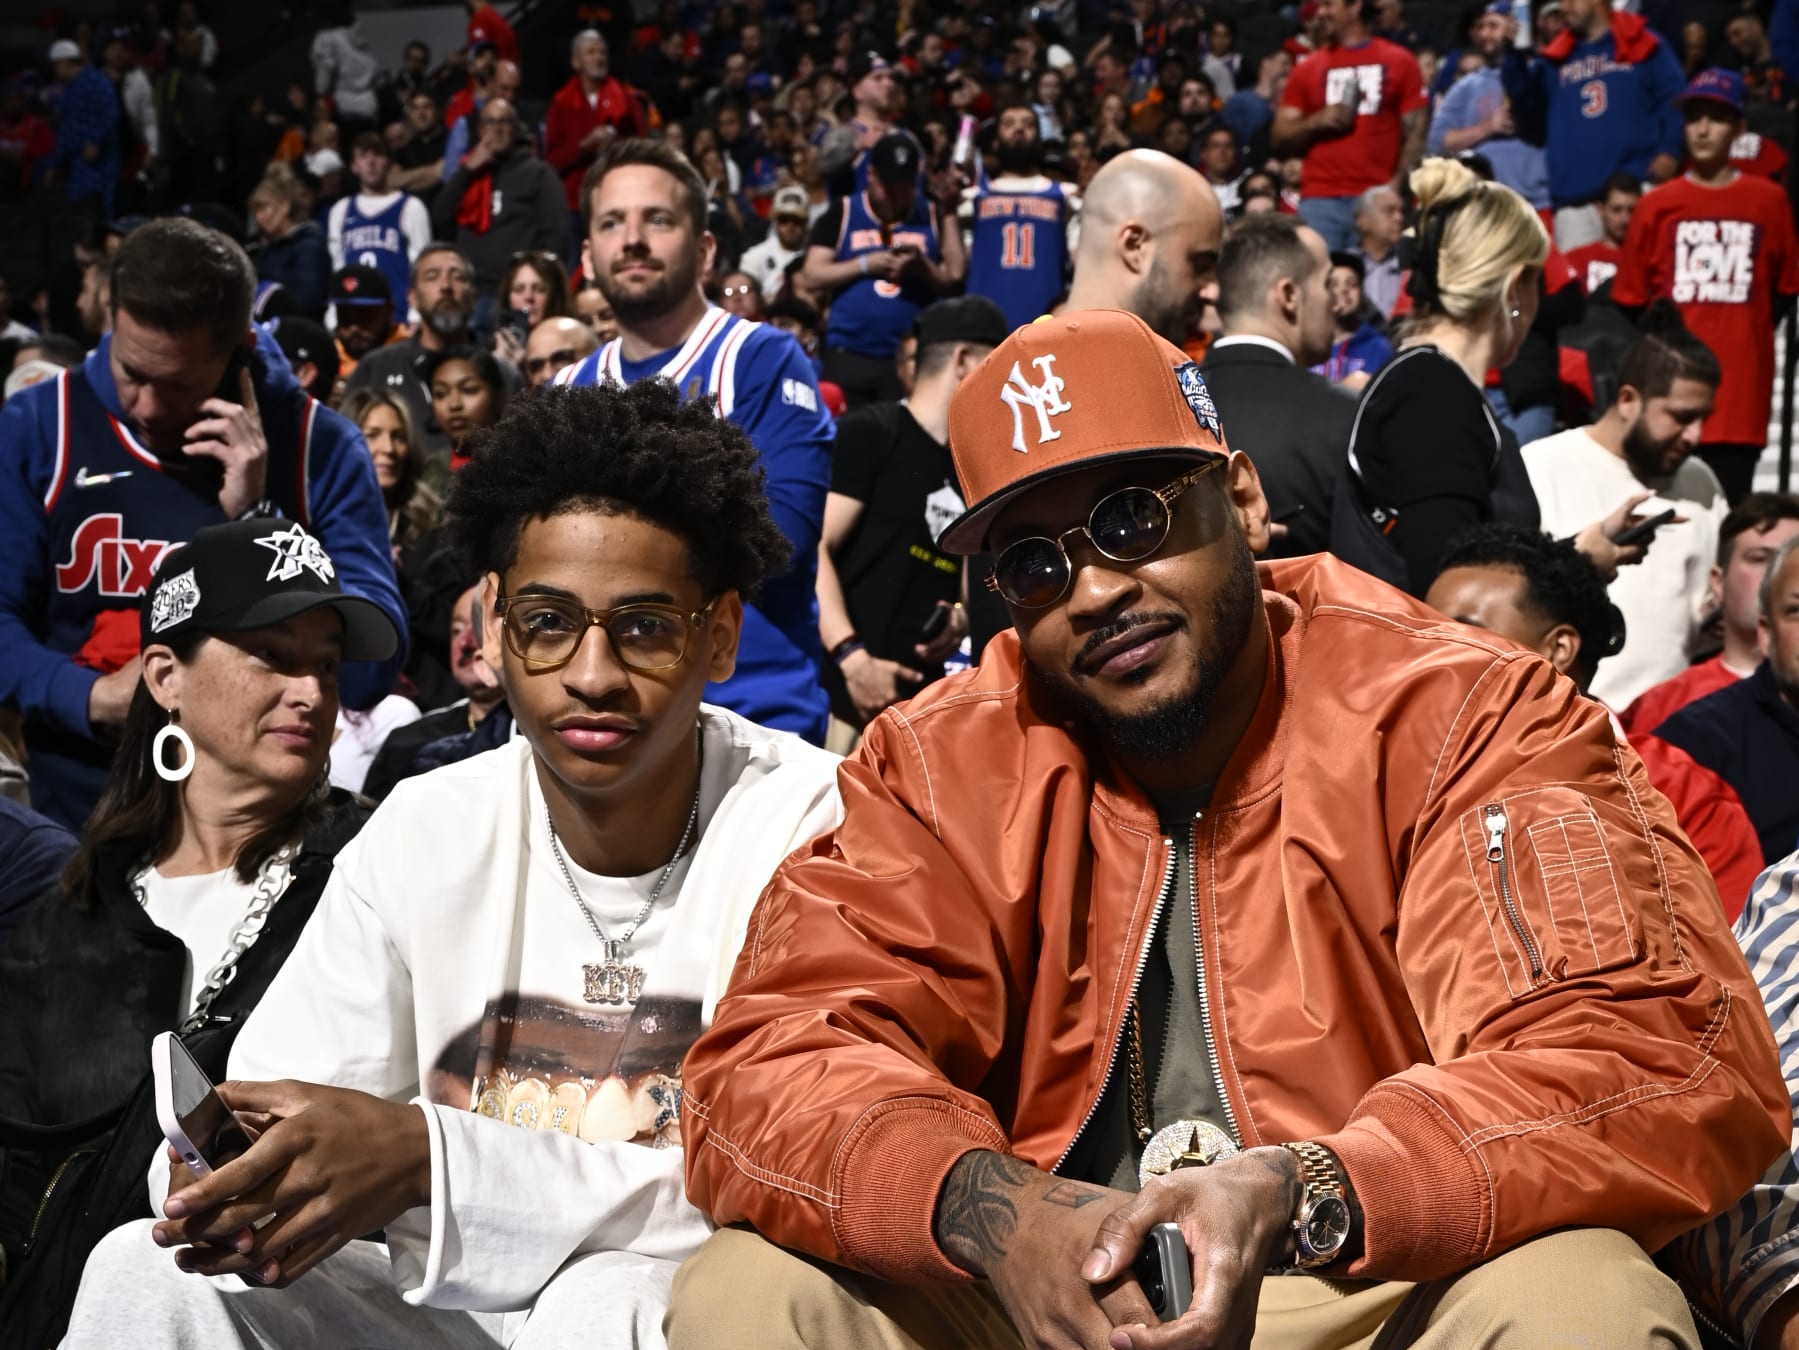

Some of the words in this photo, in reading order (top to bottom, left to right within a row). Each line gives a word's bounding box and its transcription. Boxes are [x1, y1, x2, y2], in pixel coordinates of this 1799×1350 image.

[1581, 80, 1608, 118] 3
[979, 197, 1015, 219] NEW
[1017, 196, 1059, 221] YORK
[1001, 222, 1035, 269] 11
[1677, 220, 1717, 244] FOR
[1720, 220, 1754, 243] THE
[1675, 244, 1753, 282] LOVE
[1001, 354, 1072, 453] NY
